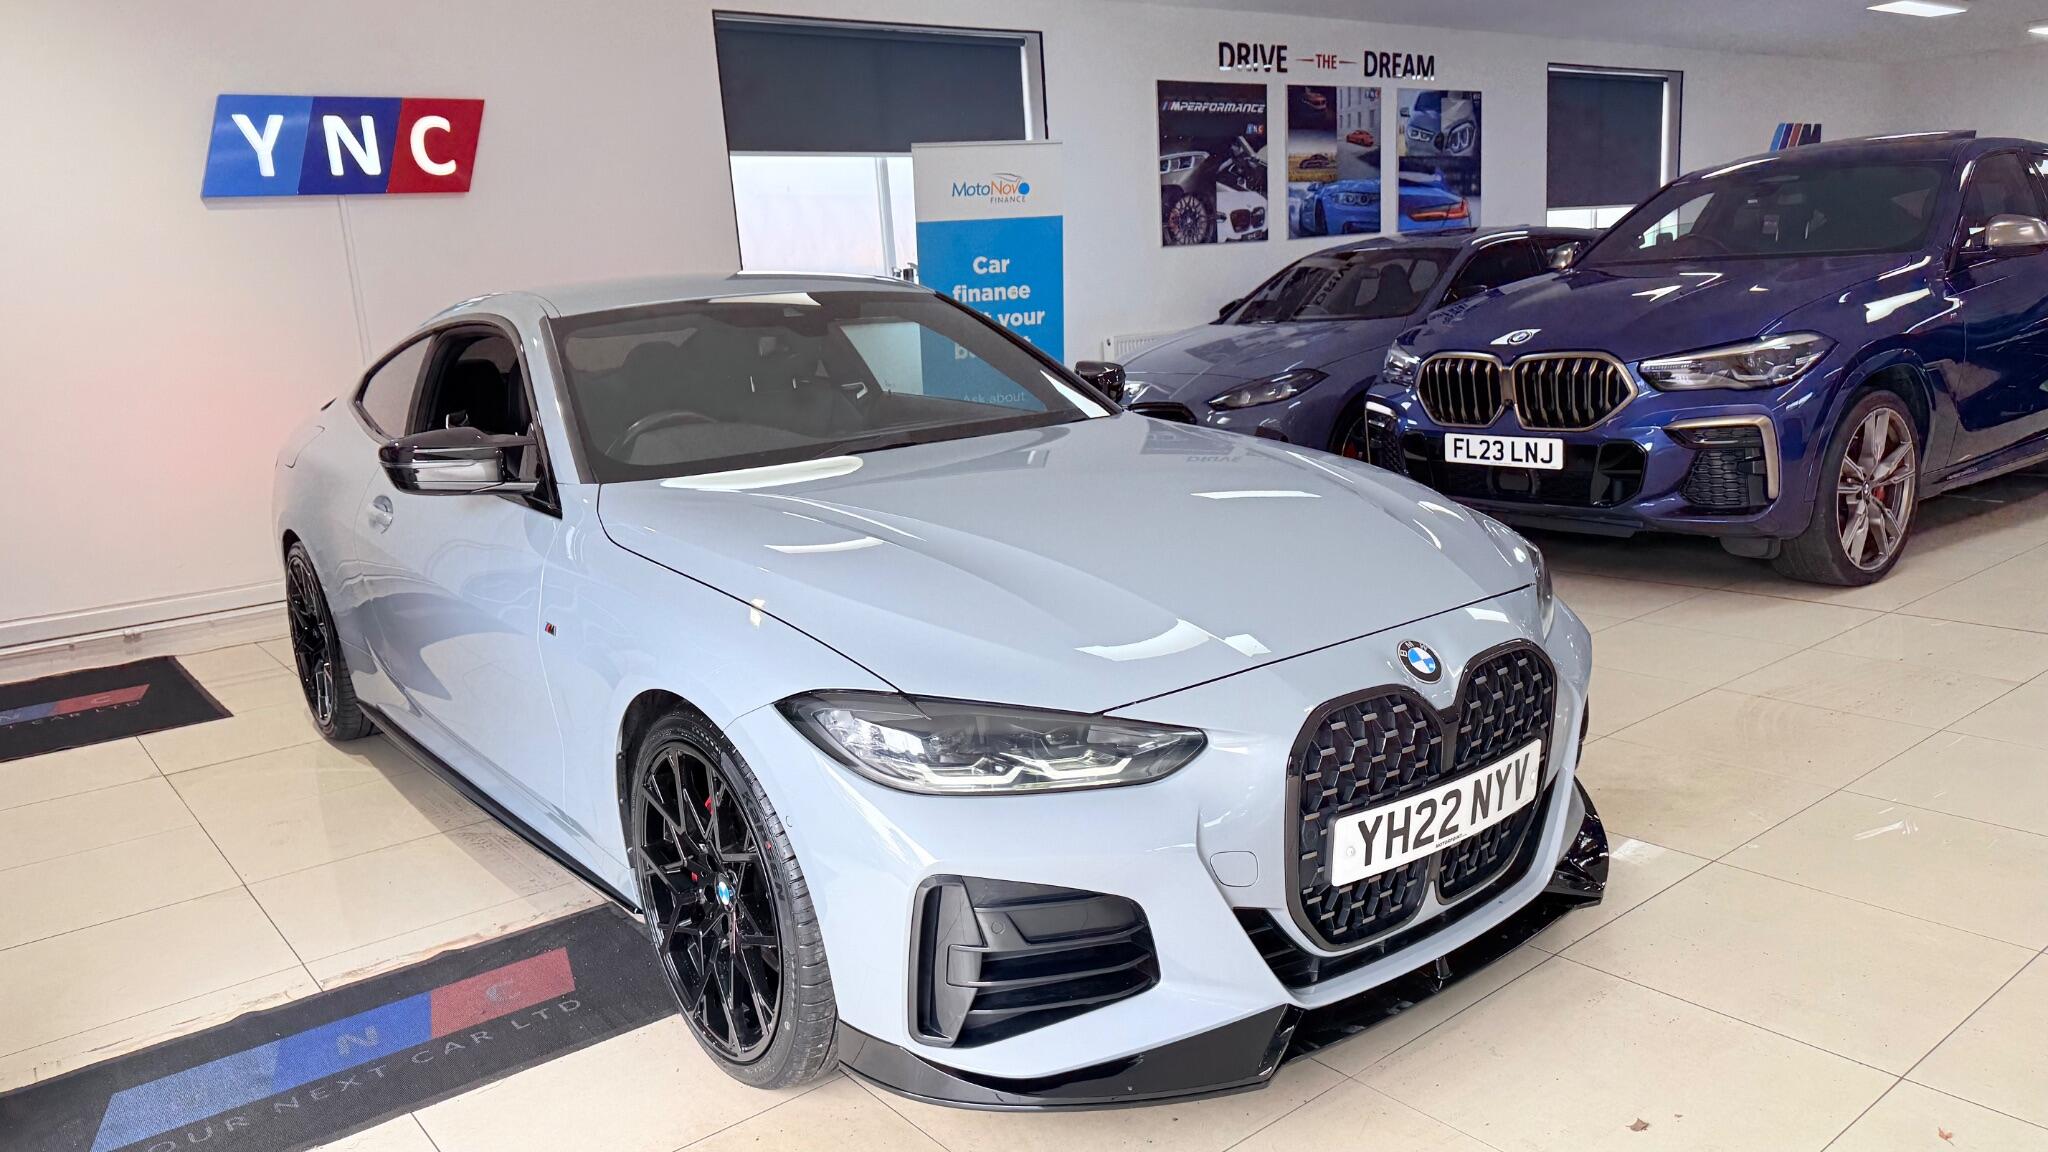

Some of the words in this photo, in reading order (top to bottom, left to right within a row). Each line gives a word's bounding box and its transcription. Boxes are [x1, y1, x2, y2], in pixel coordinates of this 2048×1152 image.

[1219, 42, 1288, 73] DRIVE
[1315, 54, 1337, 69] THE
[1364, 50, 1435, 80] DREAM
[231, 114, 457, 177] YNC
[991, 195, 1026, 204] FINANCE
[973, 256, 1010, 275] Car
[953, 284, 1031, 303] finance
[998, 310, 1046, 329] your
[989, 391, 1025, 403] about
[1454, 438, 1505, 461] FL23
[1511, 441, 1553, 463] LNJ
[1358, 789, 1462, 867] YH22
[1470, 753, 1530, 825] NYV
[273, 1064, 387, 1113] NEXT
[411, 1030, 494, 1064] CAR
[510, 1000, 581, 1031] LTD
